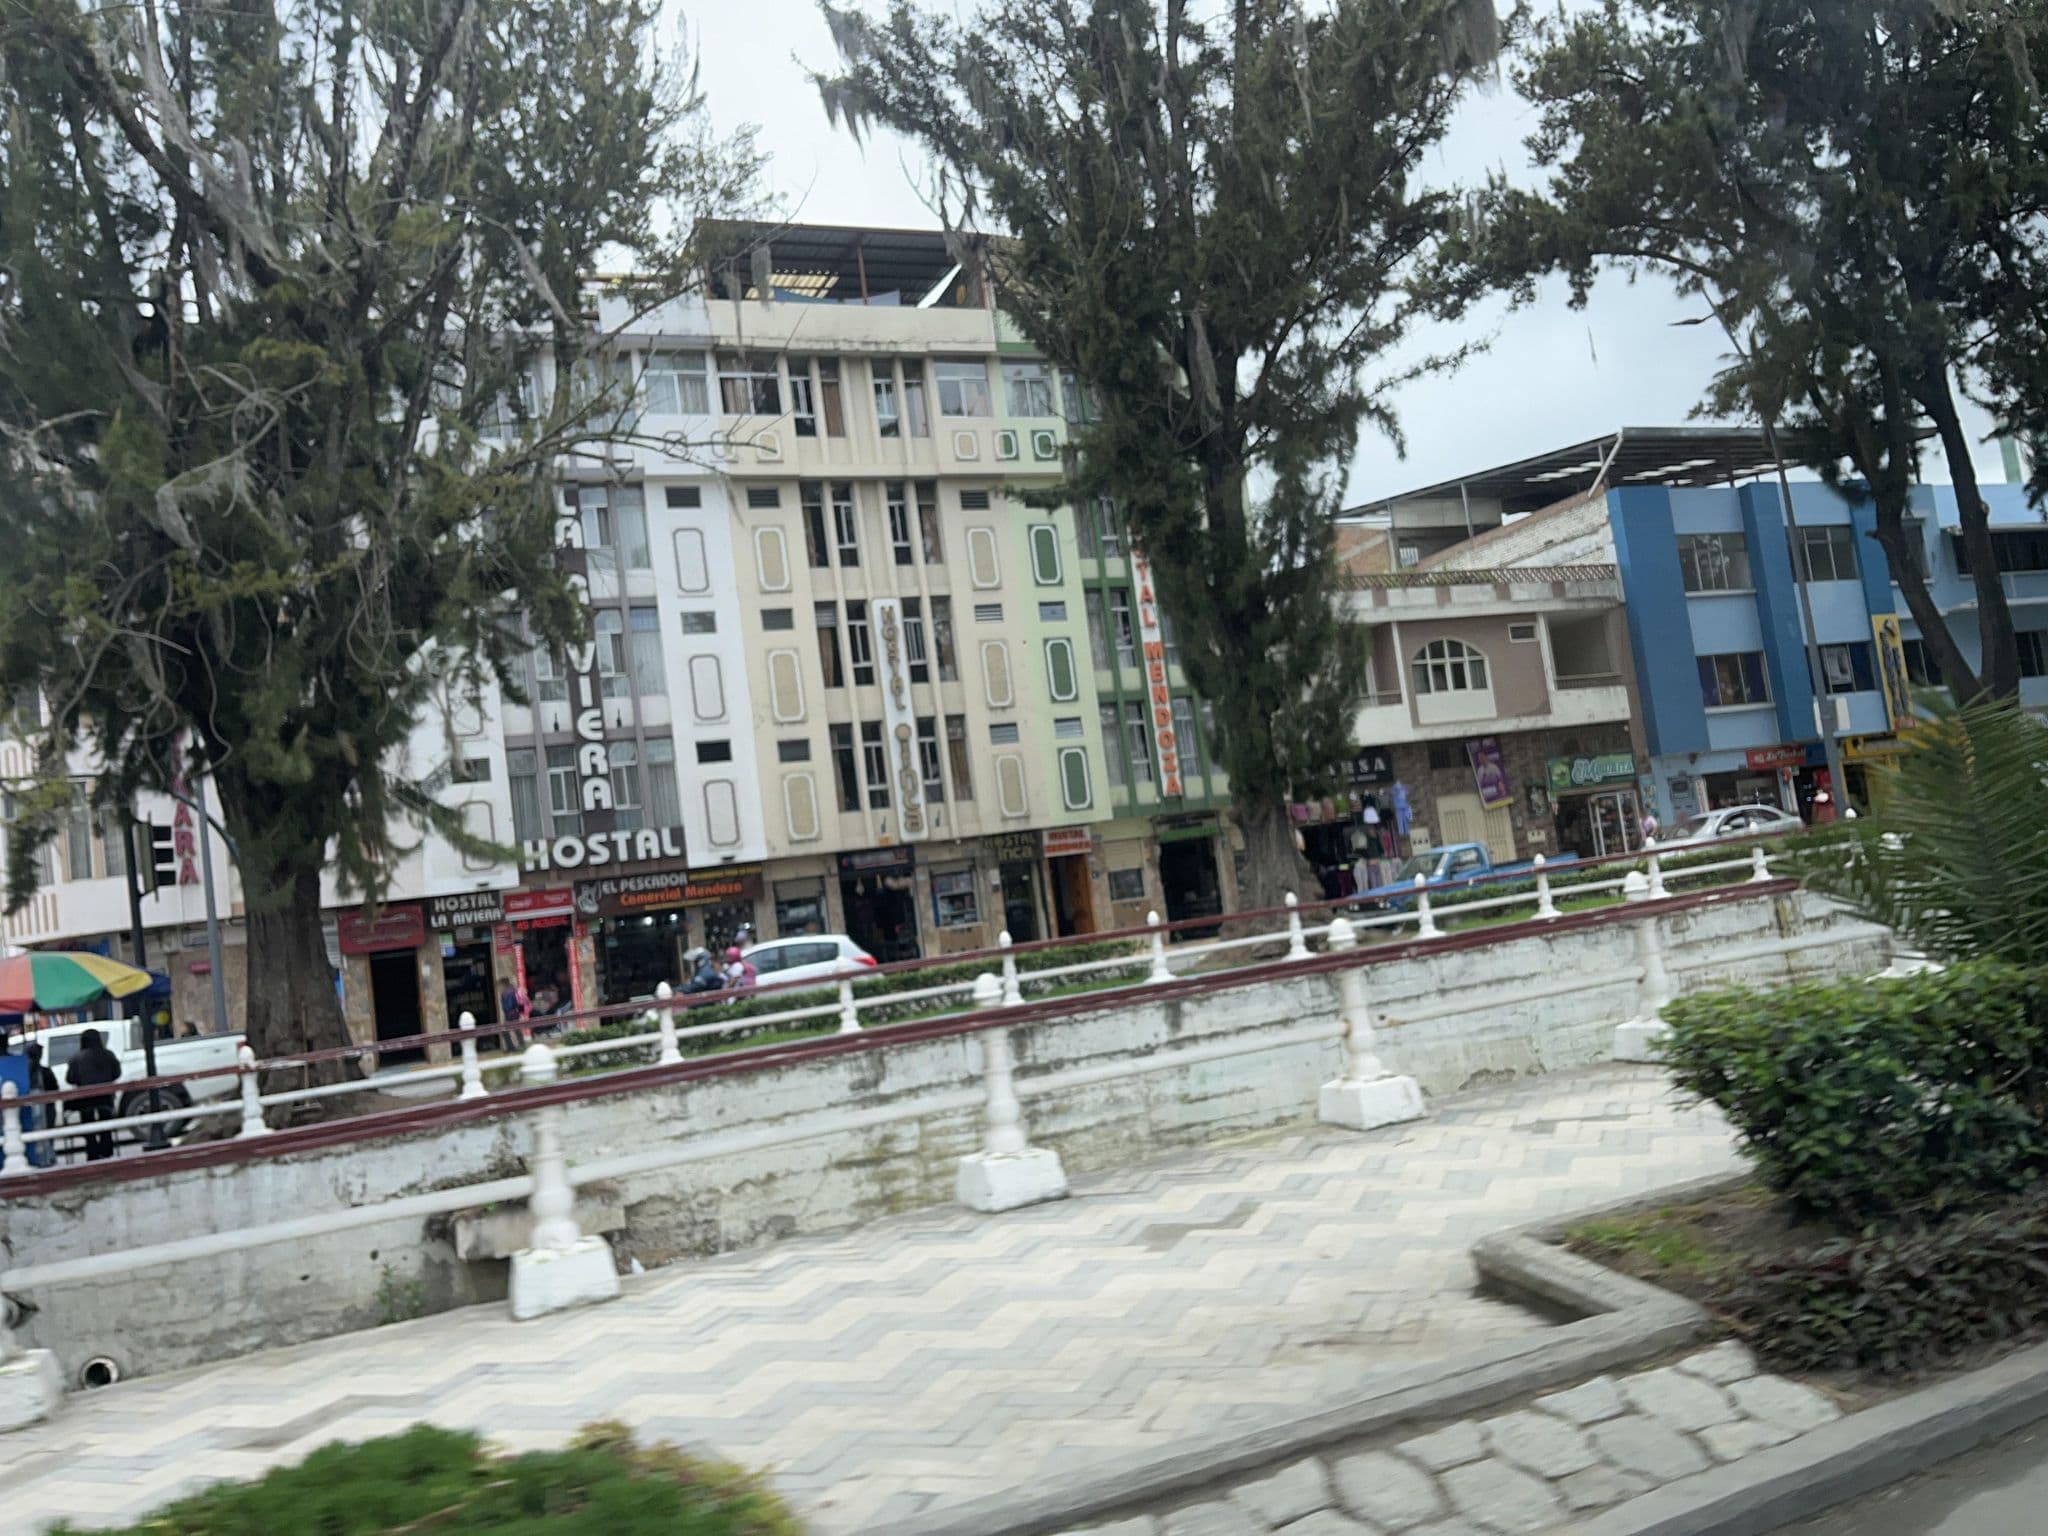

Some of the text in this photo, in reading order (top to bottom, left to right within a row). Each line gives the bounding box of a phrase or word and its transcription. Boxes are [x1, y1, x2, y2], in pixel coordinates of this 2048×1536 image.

[1143, 641, 1182, 794] MENDOZA
[523, 826, 681, 872] HOSTAL
[602, 881, 617, 895] EL
[620, 872, 688, 892] PESCADOR
[620, 888, 681, 906] Comercial
[685, 882, 743, 899] Mendoza
[434, 893, 497, 913] HOSTAL
[430, 908, 501, 929] LA RIVIERA
